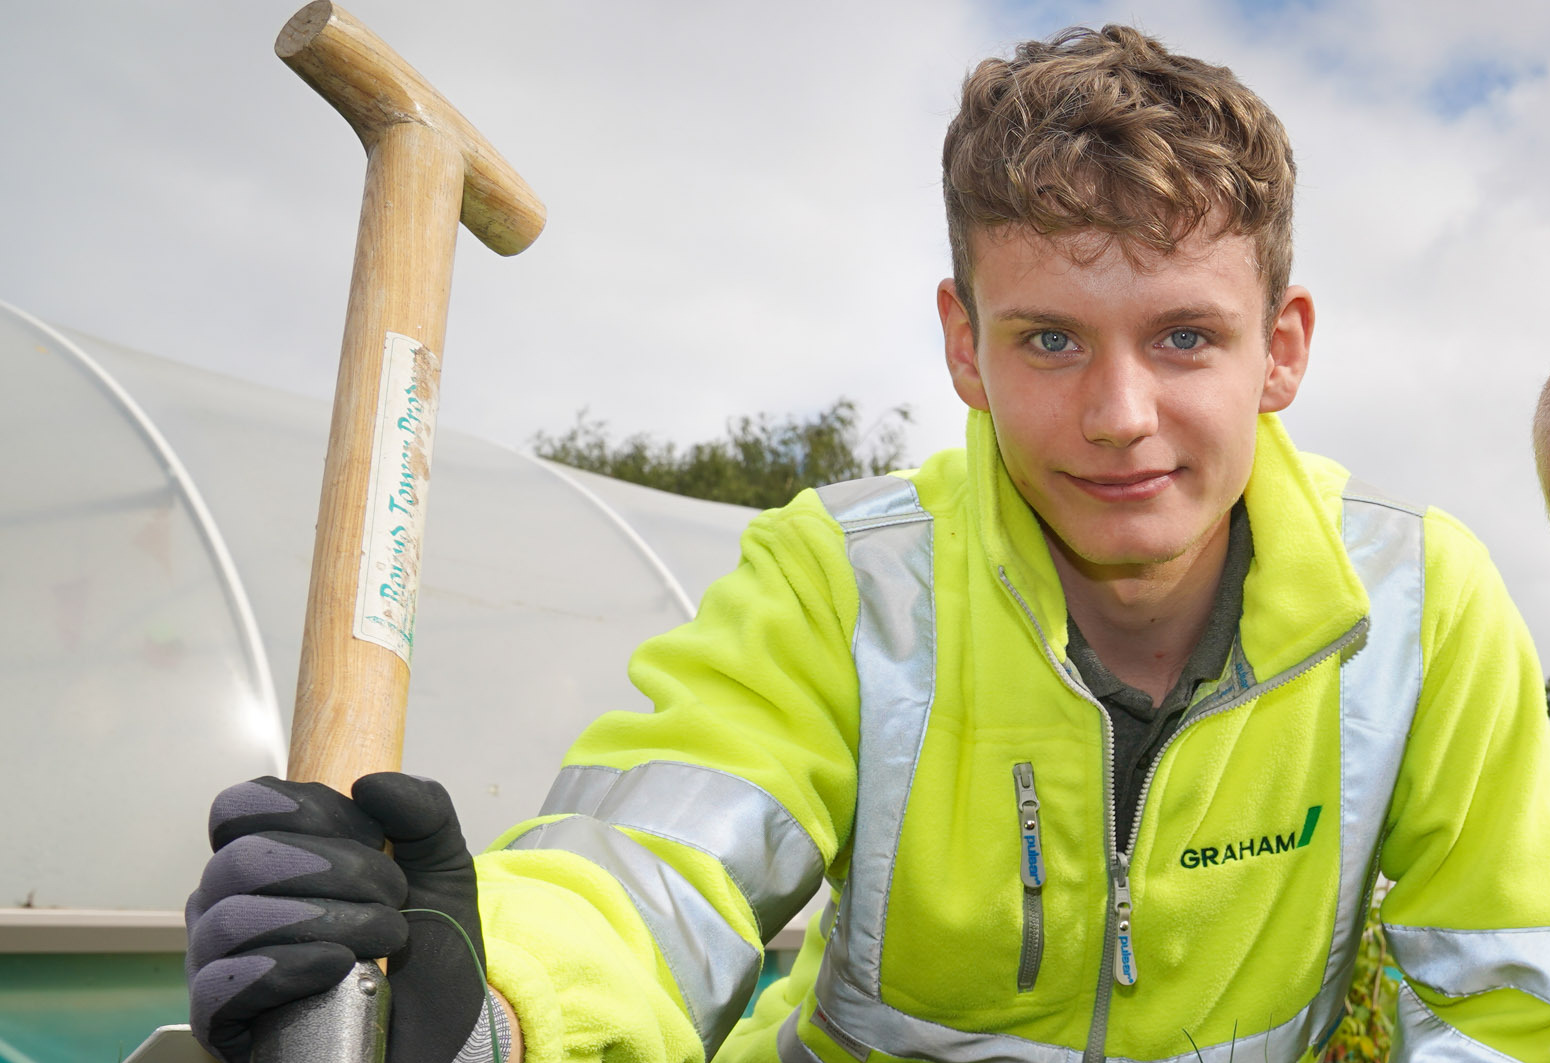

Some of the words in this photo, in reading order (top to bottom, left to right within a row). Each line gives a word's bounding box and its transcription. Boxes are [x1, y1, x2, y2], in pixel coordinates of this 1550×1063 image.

[1024, 835, 1041, 885] pulsar
[1180, 832, 1296, 869] GRAHAM
[1118, 936, 1134, 983] pulsar
